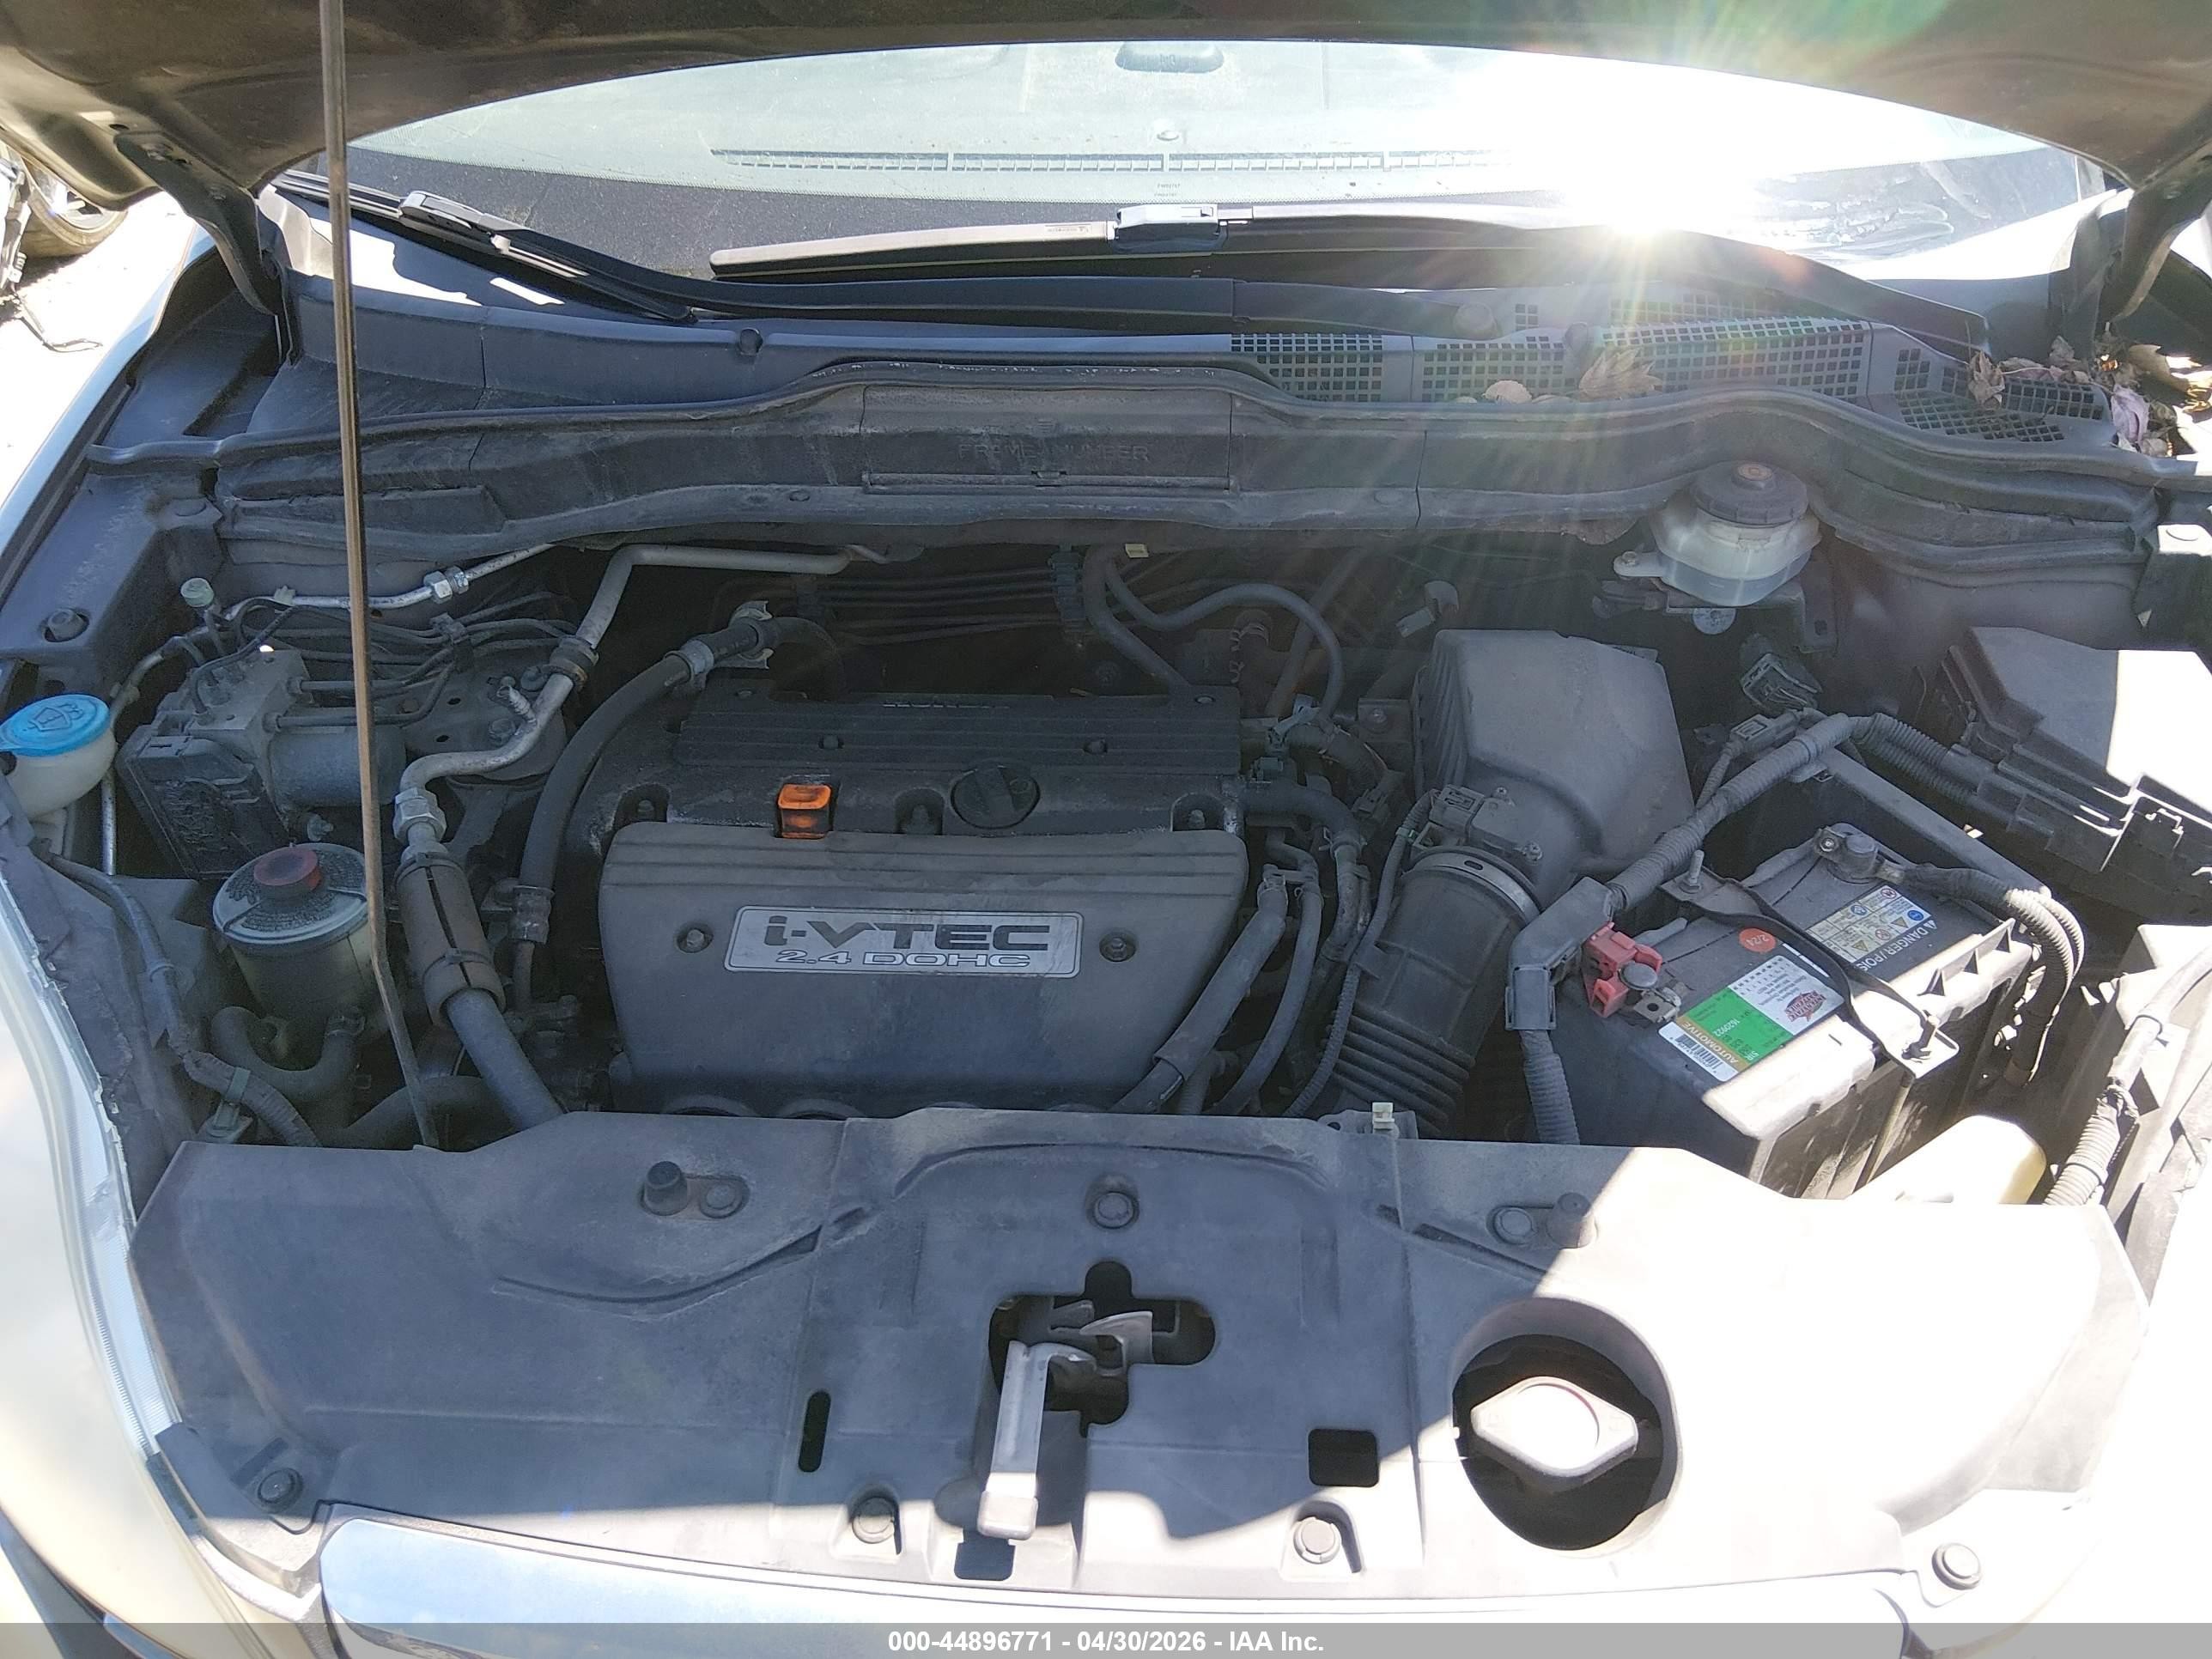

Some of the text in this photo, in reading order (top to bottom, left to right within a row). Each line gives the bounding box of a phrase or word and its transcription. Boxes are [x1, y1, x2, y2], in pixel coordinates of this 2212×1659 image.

[957, 442, 1150, 462] FRAME NUMBER
[763, 915, 1051, 951] i-VTEC
[1745, 934, 1770, 947] 2/24
[1885, 928, 1929, 956] DANGER
[776, 950, 1030, 967] 2.4 DOHC
[1856, 953, 1884, 972] POIS
[1784, 989, 1820, 1015] BATTERIES
[1787, 994, 1827, 1022] INTERSTATE
[1680, 1021, 1739, 1064] AUTOMOTIVE
